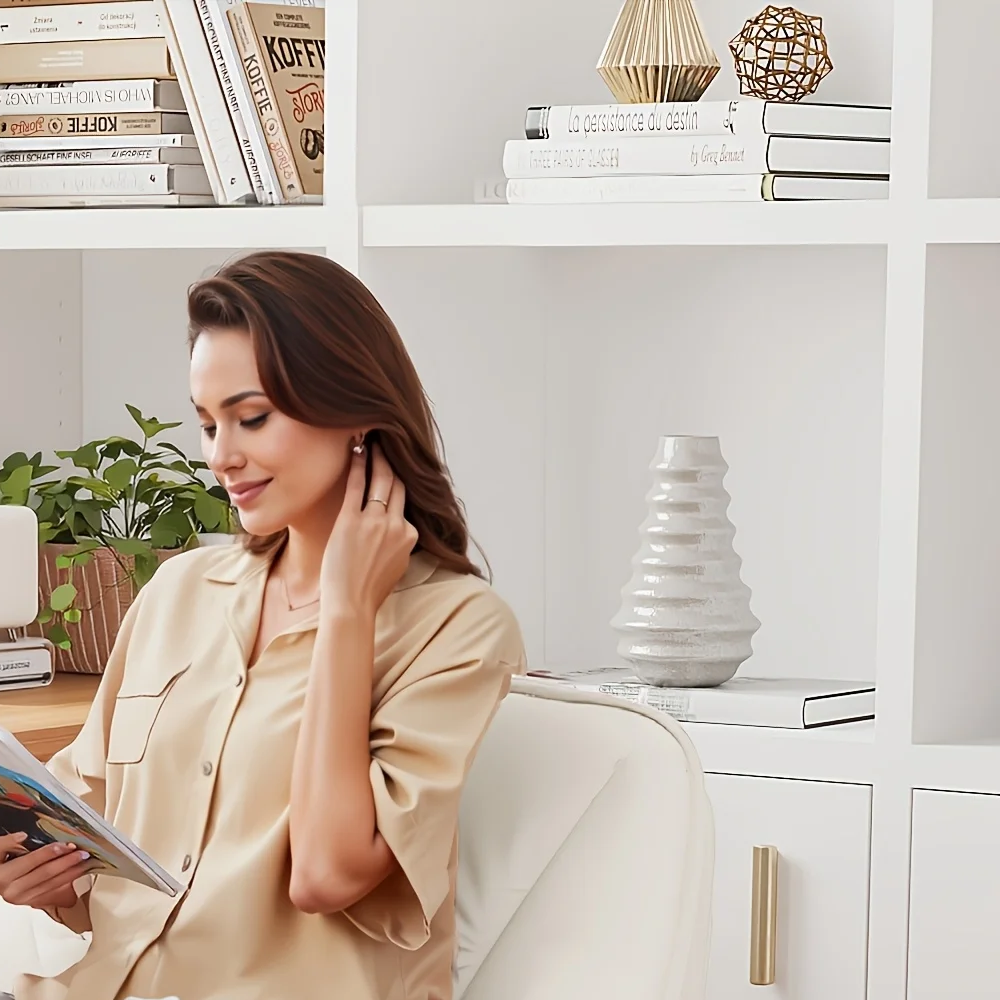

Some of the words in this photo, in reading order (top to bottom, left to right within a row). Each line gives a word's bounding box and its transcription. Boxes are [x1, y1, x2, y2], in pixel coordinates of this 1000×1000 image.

[47, 90, 103, 105] MICHAEL
[105, 89, 116, 103] IS
[118, 88, 152, 102] WHO
[285, 82, 324, 123] STORI
[10, 116, 45, 136] STORIES
[67, 116, 118, 133] KOFFIE
[244, 54, 273, 116] KOFFIE
[269, 138, 294, 180] STORIES
[568, 106, 580, 133] La
[583, 106, 644, 138] persistance
[647, 105, 662, 132] du
[665, 103, 699, 131] destin
[690, 144, 699, 167] by
[700, 144, 718, 167] Greg
